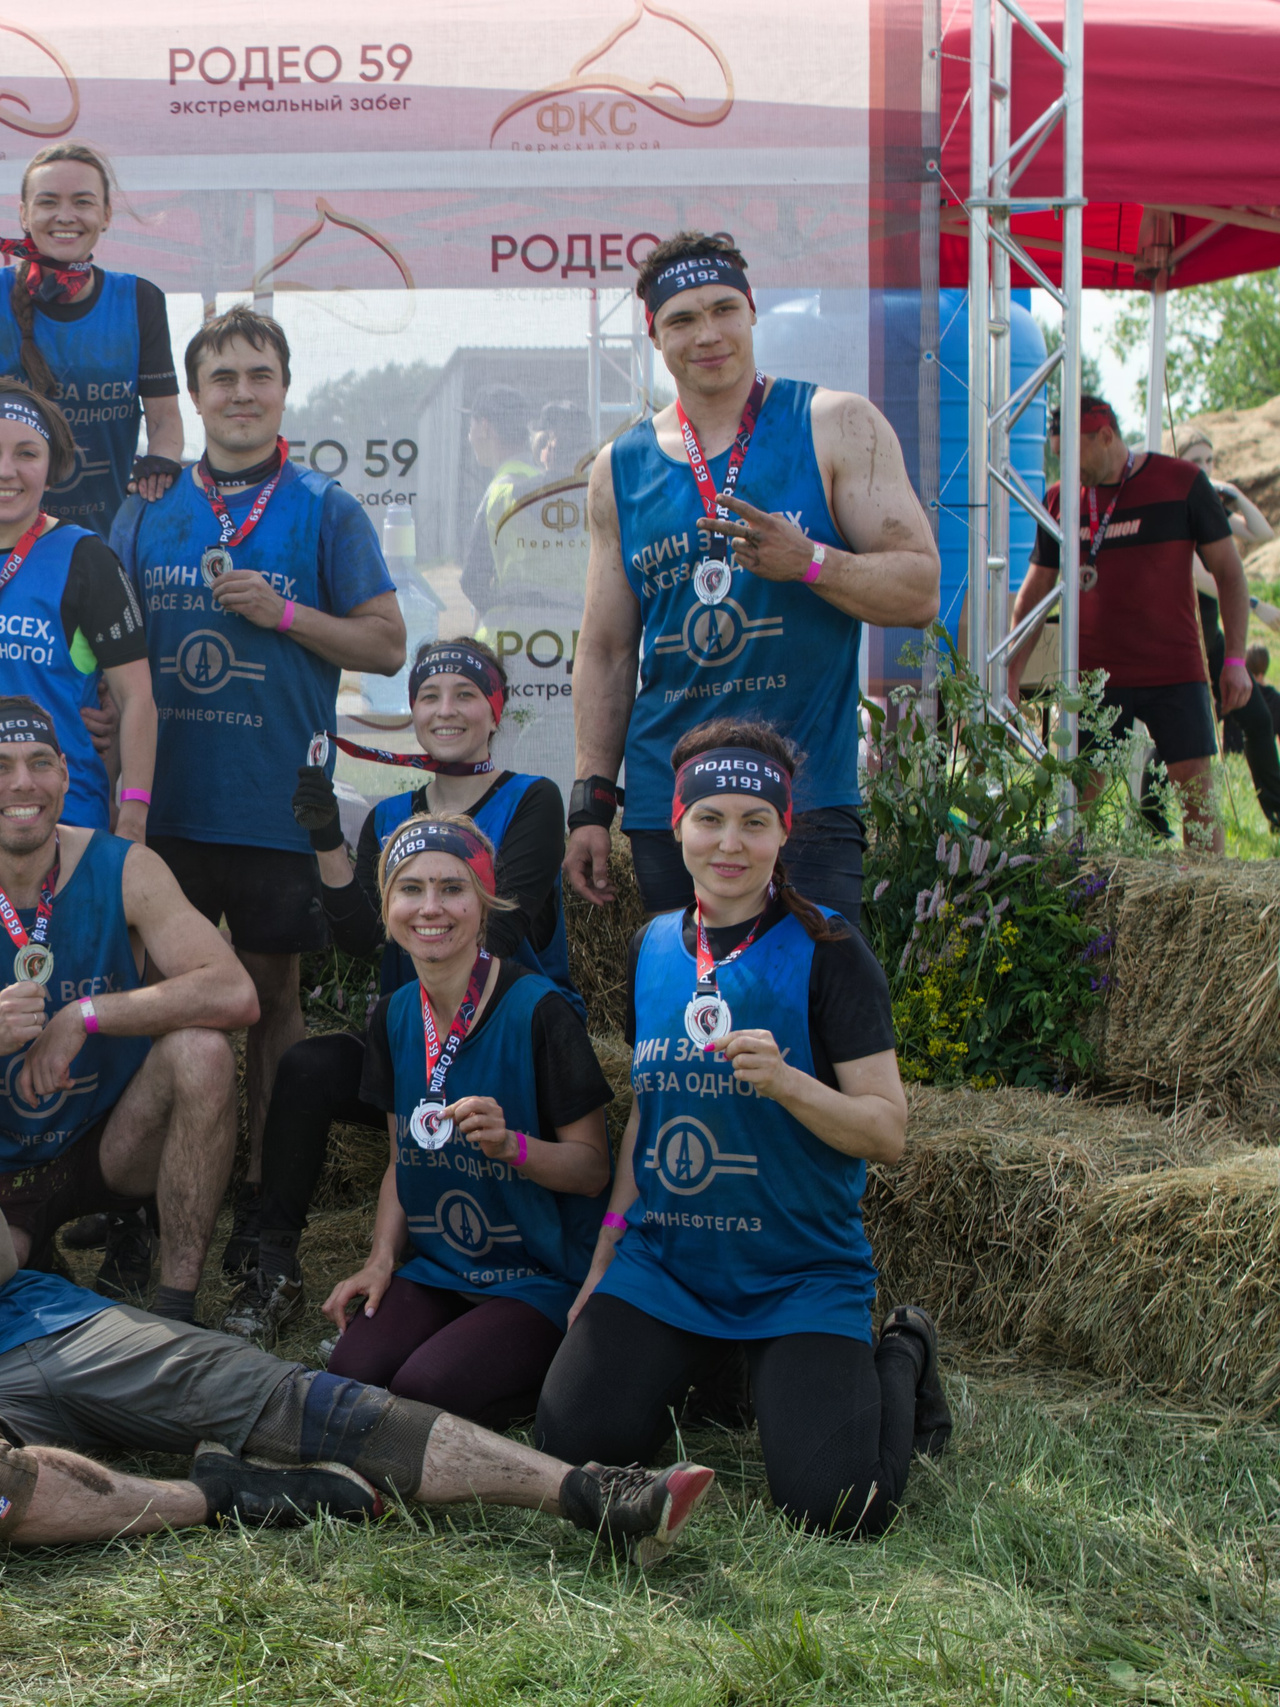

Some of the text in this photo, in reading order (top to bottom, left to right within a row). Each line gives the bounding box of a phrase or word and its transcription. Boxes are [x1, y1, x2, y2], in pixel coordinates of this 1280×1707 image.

[168, 43, 413, 91] РОДЕО 59
[169, 93, 412, 117] экстремальный забег
[537, 102, 637, 136] ФКС
[657, 257, 711, 284] РОДЕО
[675, 270, 719, 287] 3192
[87, 380, 136, 401] ВСЕХ,
[3, 402, 39, 418] 3184
[364, 438, 419, 478] 59
[682, 422, 708, 483] РОДЕО 59
[728, 466, 739, 484] 59
[219, 514, 232, 529] 59
[249, 508, 263, 521] 59
[145, 565, 197, 590] ОДИН
[182, 594, 205, 611] ЗА
[417, 652, 482, 674] РОДЕО 59
[429, 663, 462, 676] 3187
[33, 720, 49, 730] 59
[695, 760, 780, 783] РОДЕО 59
[716, 776, 762, 791] 3193
[394, 839, 425, 867] 3189
[9, 919, 22, 936] 59
[36, 917, 48, 930] 59
[423, 1001, 439, 1057] РОДЕО 59
[674, 1038, 705, 1062] ЗА
[430, 1035, 460, 1092] РОДЕО 59
[656, 1071, 680, 1092] ЗА
[427, 1151, 451, 1169] ЗА
